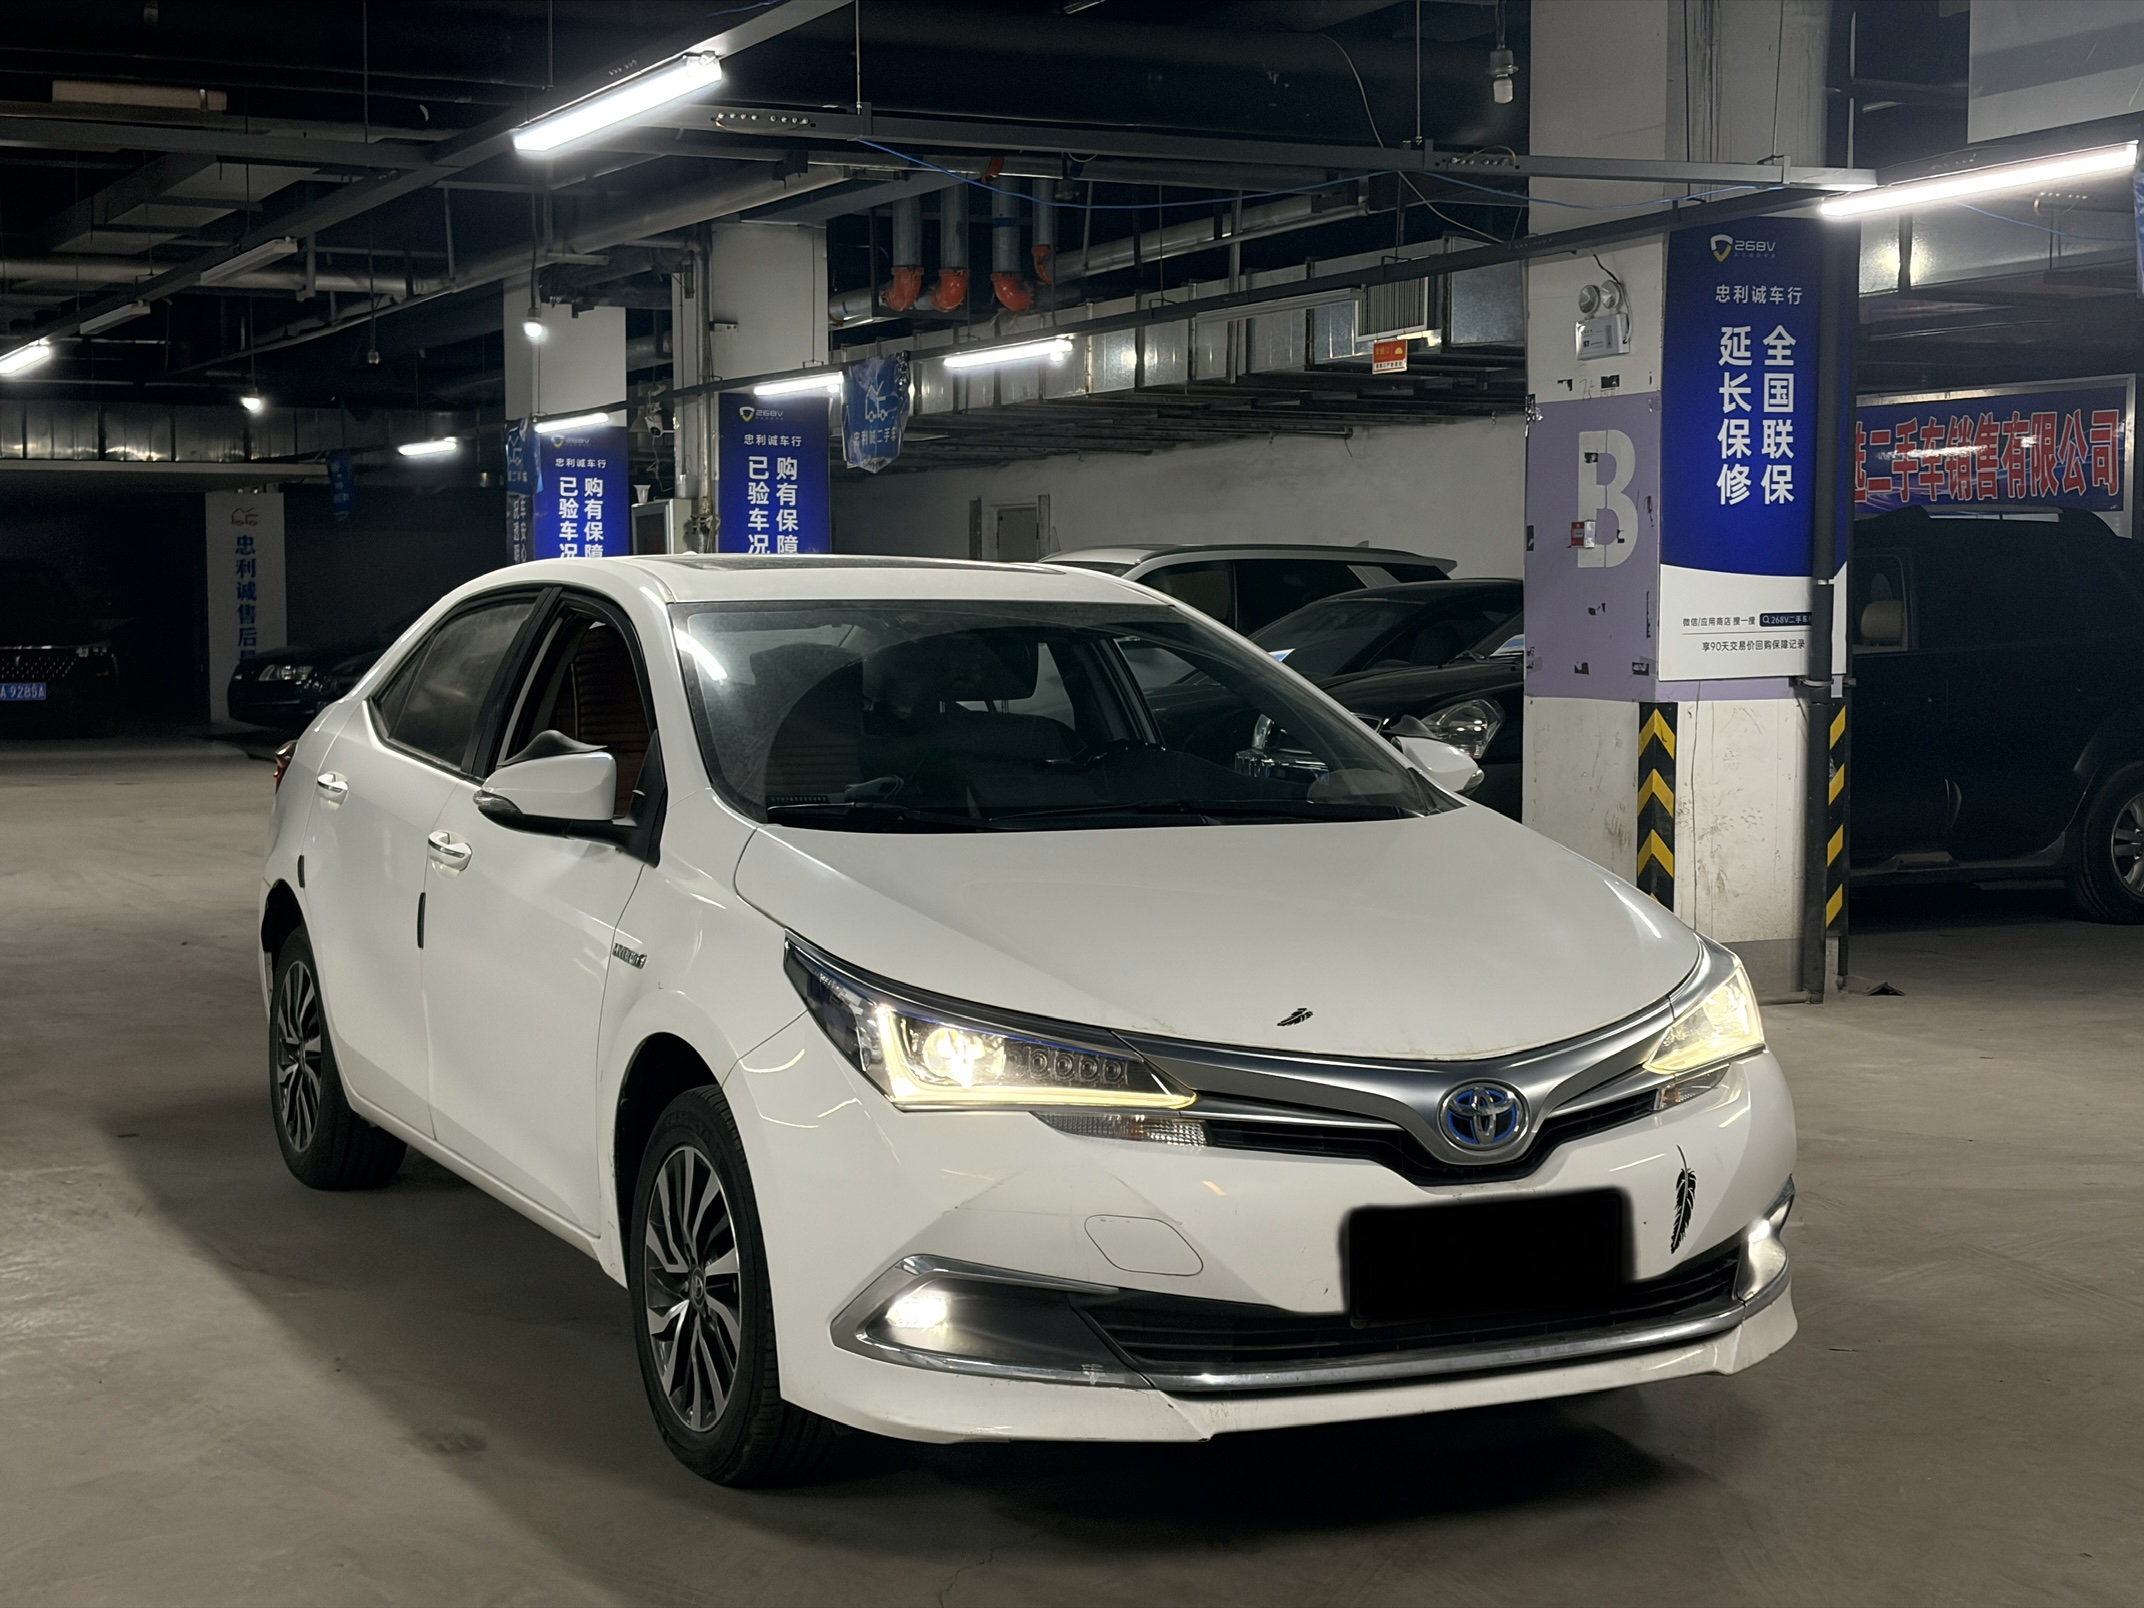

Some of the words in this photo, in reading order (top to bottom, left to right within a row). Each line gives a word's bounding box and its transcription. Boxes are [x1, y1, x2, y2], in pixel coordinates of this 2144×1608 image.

[1734, 240, 1776, 252] 268V
[1715, 284, 1803, 305] 忠利诚车行
[755, 409, 784, 418] 268V
[1716, 325, 1753, 505] 延长保修
[1760, 324, 1797, 504] 全国联保
[555, 458, 607, 469] 忠利诚车行
[744, 434, 802, 447] 忠利诚车行
[559, 476, 579, 558] 已验车况
[584, 478, 604, 558] 购有保障
[747, 456, 770, 554] 已验车况
[776, 457, 799, 554] 购有保障
[1577, 429, 1639, 569] B
[1682, 616, 1732, 627] 微信/应用商店
[1733, 616, 1756, 626] 搜一搜
[1771, 615, 1812, 624] 268V二手车
[1702, 639, 1806, 652] 享90天交易价回购保障记录
